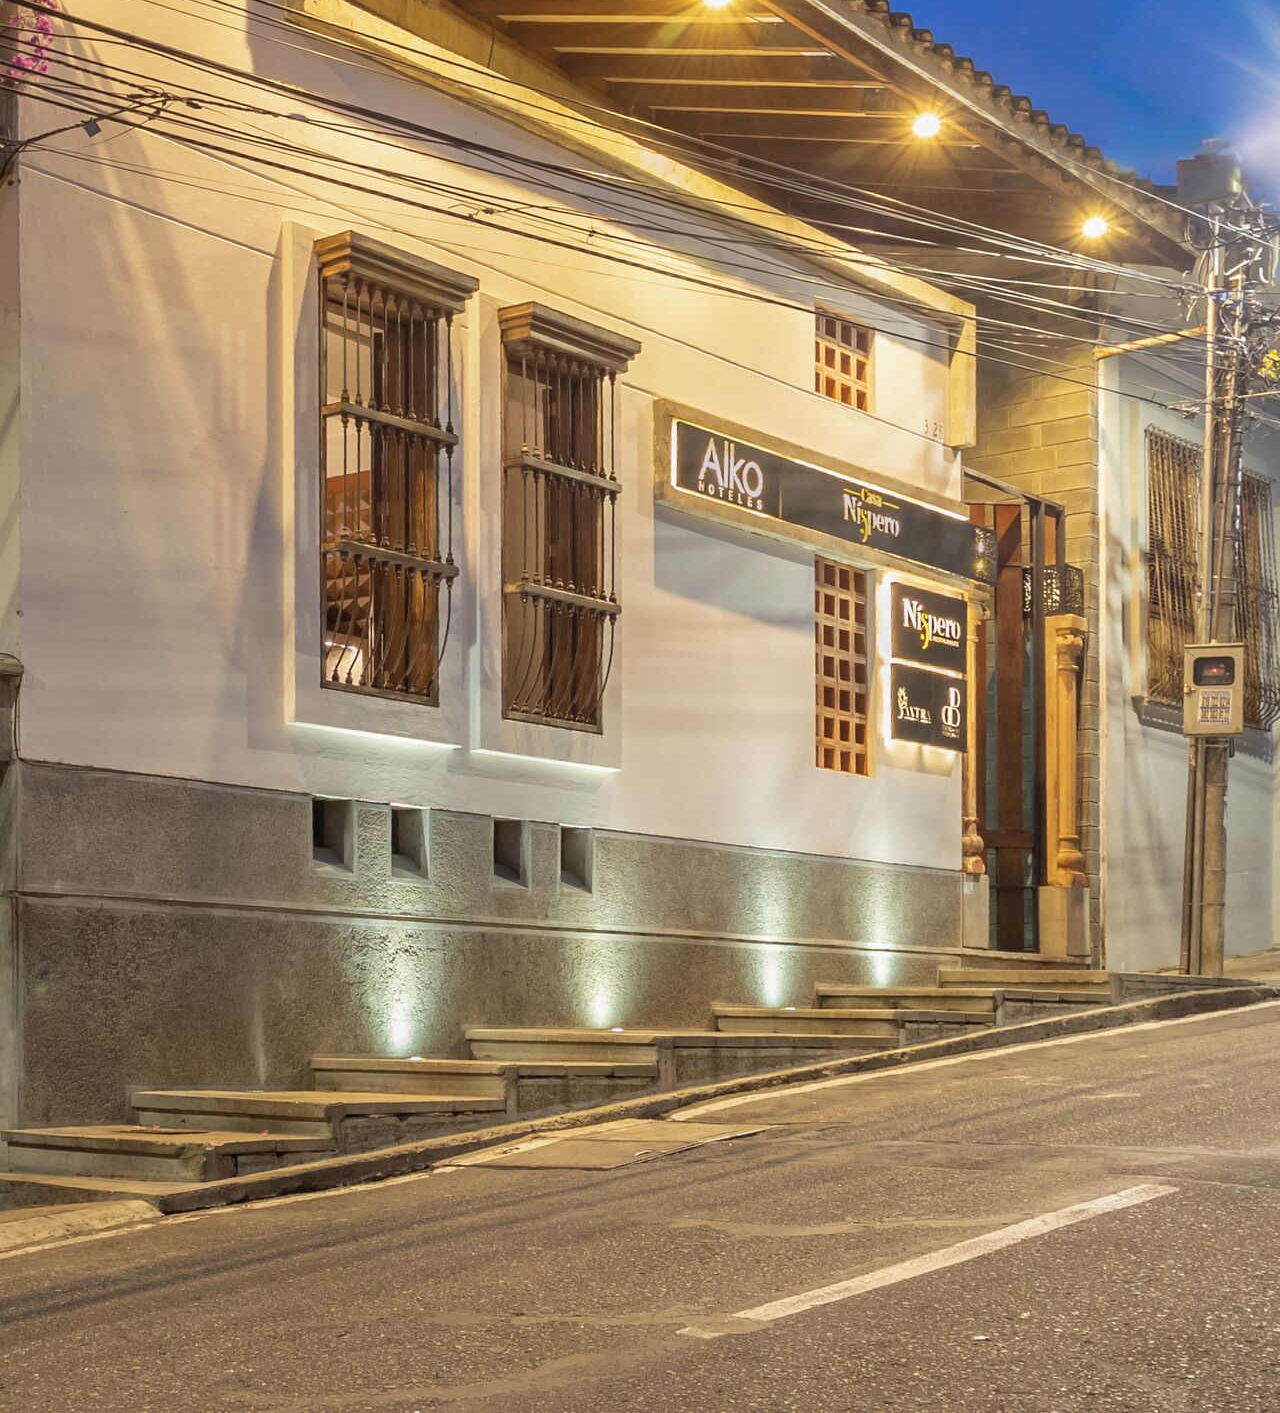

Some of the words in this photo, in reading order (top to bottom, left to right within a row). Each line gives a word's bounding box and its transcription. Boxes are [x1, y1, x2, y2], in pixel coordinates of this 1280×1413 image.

[698, 437, 763, 498] Alko
[698, 480, 763, 510] HOTELES
[860, 488, 883, 507] Casa
